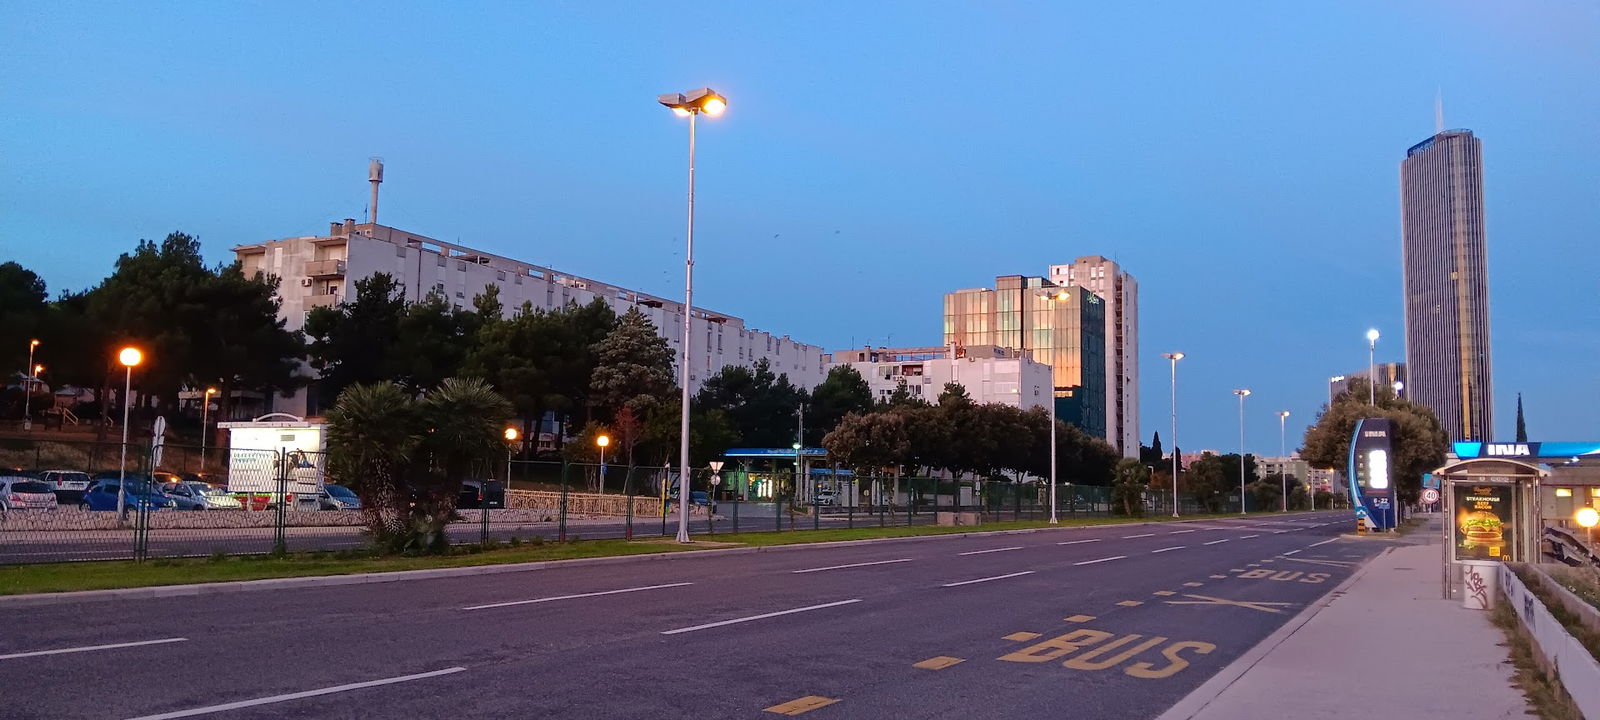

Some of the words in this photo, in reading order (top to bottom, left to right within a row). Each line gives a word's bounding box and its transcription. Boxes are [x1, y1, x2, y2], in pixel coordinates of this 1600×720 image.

[1488, 444, 1530, 455] INA
[1425, 491, 1436, 500] 40
[1237, 569, 1331, 584] BUS
[996, 628, 1217, 679] BUS
